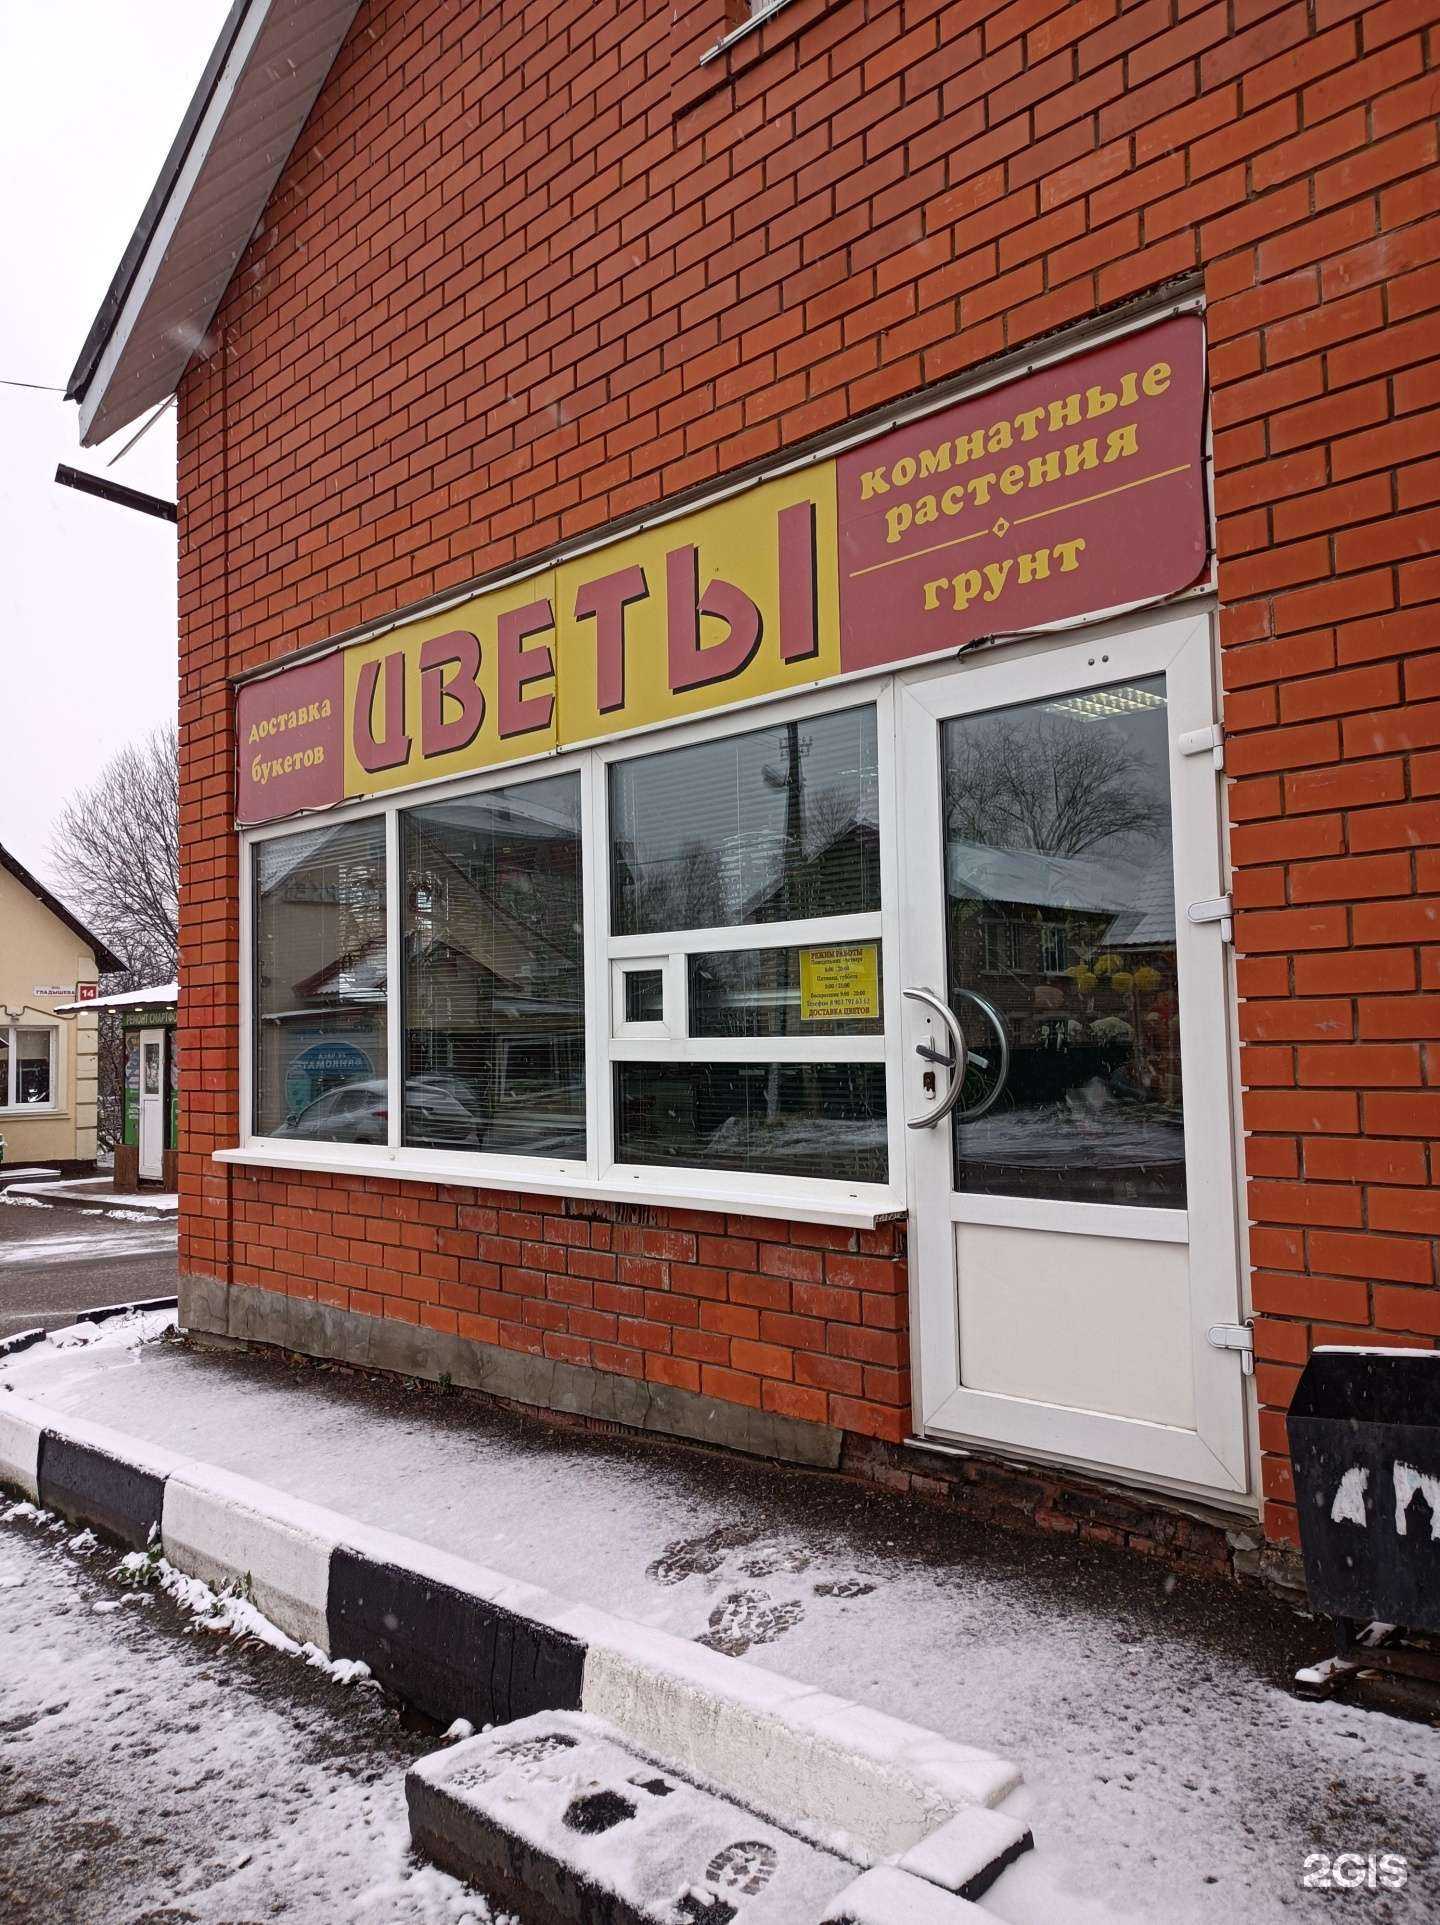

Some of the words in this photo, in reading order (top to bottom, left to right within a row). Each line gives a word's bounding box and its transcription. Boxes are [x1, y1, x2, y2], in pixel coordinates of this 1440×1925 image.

[859, 362, 1172, 501] комнатные
[884, 423, 1139, 543] растения
[922, 537, 1086, 611] грунт
[352, 499, 818, 774] ЦВЕТЫ
[251, 744, 325, 785] букетов
[82, 989, 94, 997] 14
